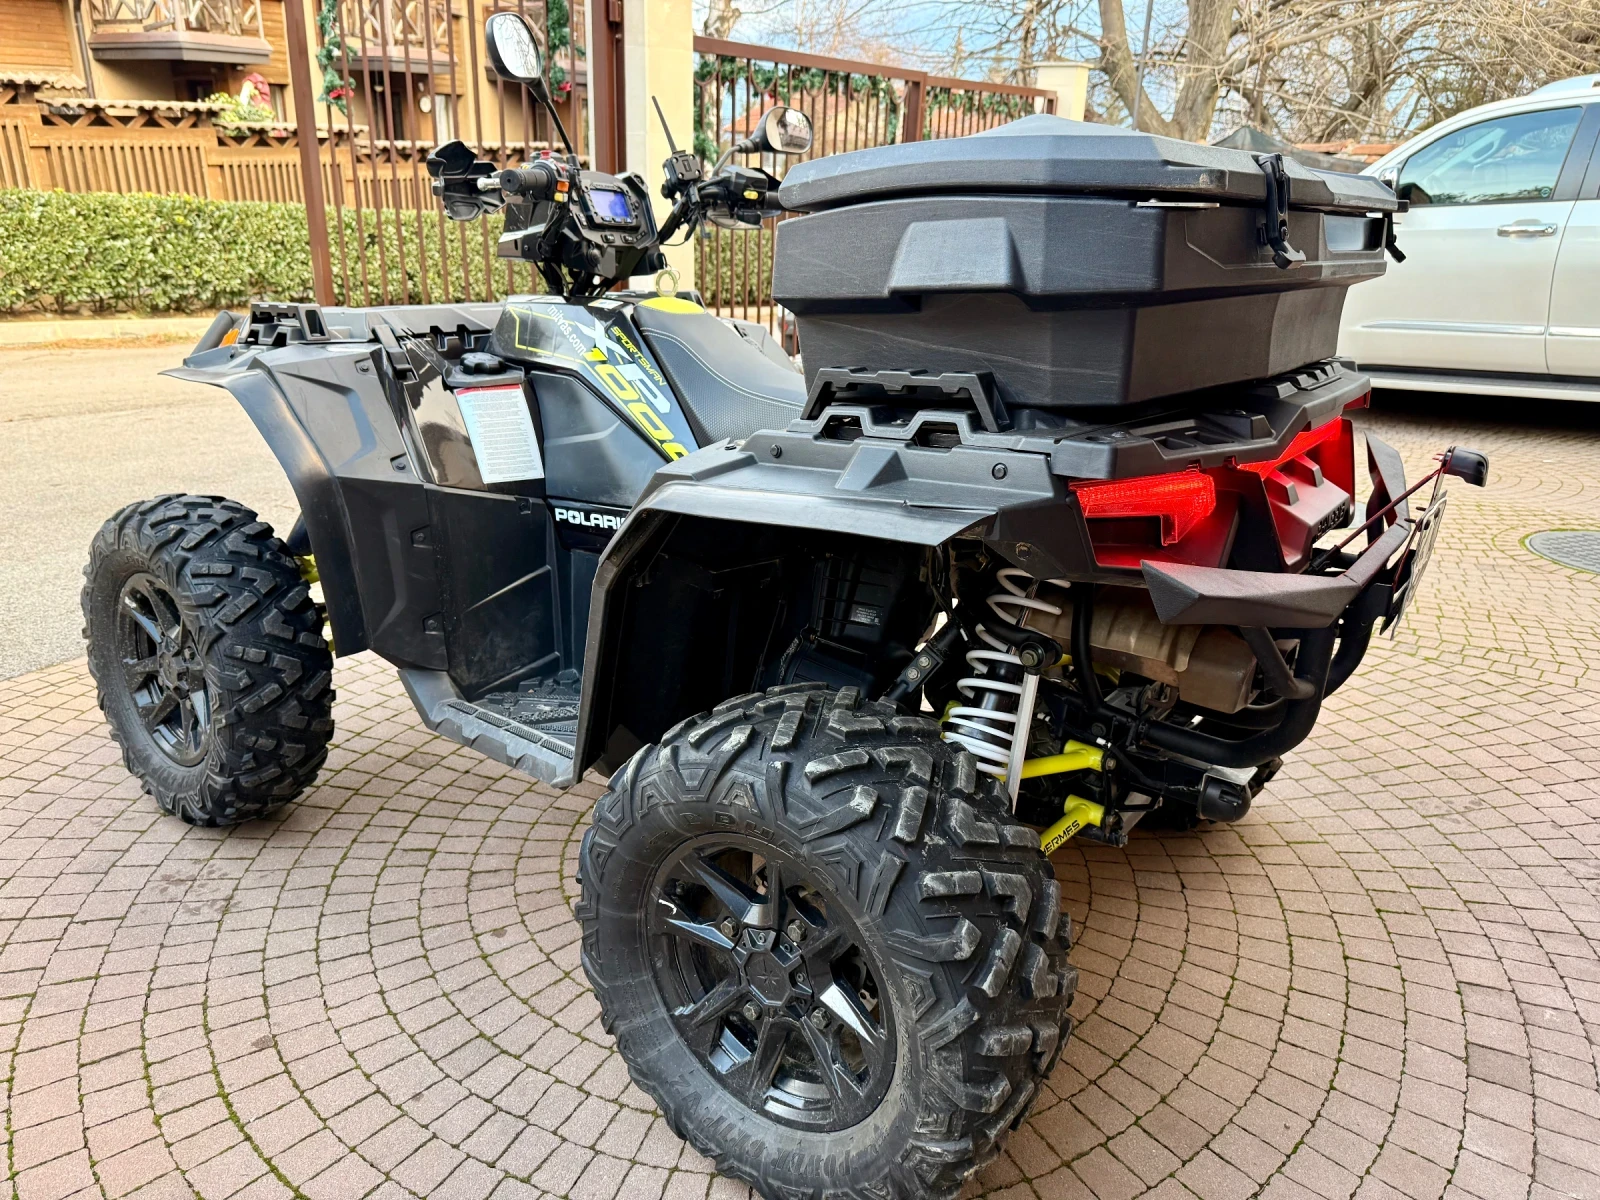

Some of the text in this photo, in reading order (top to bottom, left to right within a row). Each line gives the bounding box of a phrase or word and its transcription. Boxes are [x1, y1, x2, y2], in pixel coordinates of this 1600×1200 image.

[547, 304, 588, 357] mitvas.com
[610, 326, 667, 386] SPORTSMAN
[574, 317, 671, 414] XP
